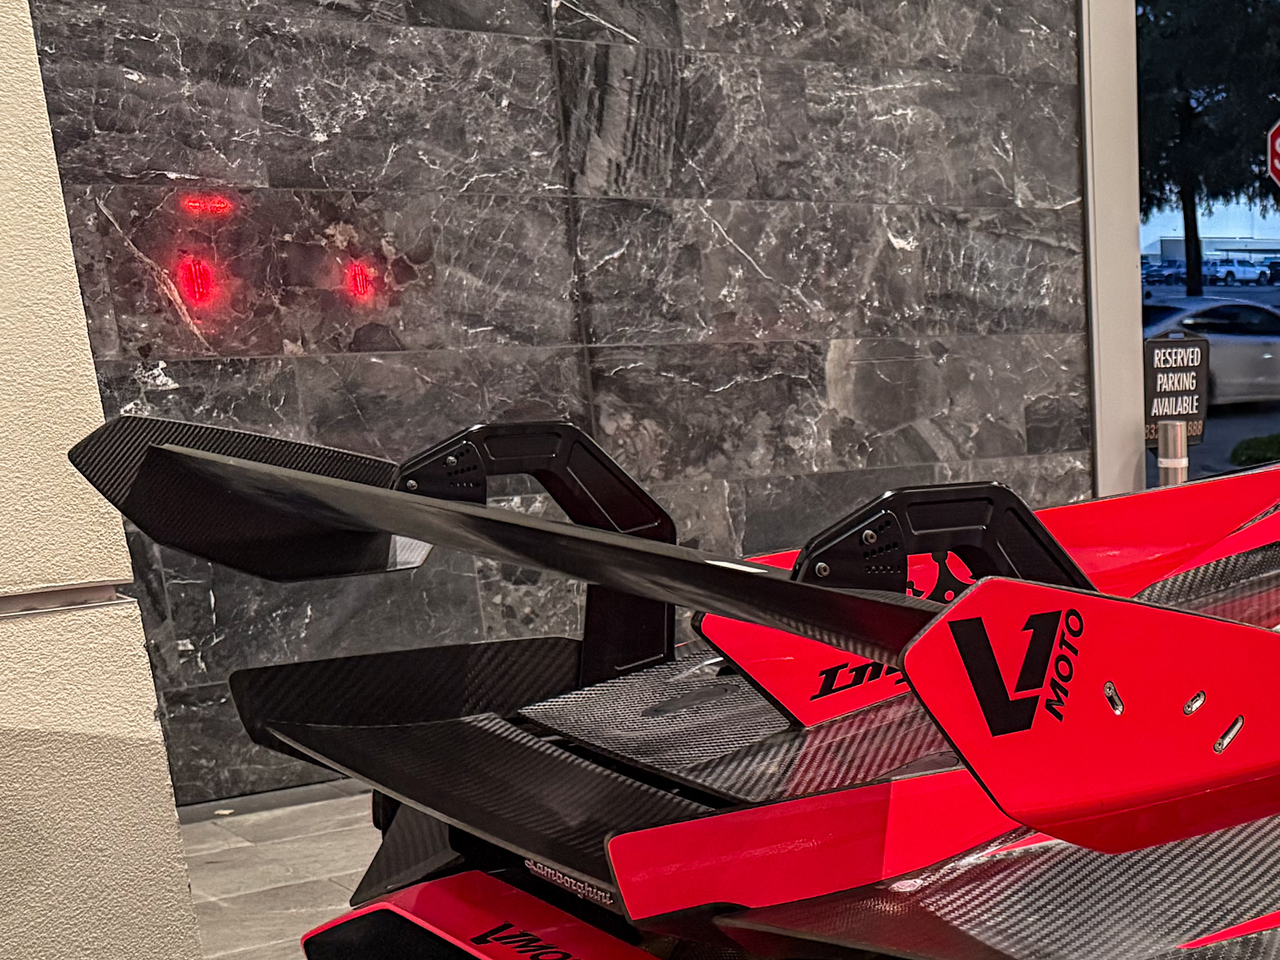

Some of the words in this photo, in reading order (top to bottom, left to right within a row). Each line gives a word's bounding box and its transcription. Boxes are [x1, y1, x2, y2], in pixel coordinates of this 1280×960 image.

[1153, 348, 1201, 368] RESERVED
[1156, 371, 1196, 393] PARKING
[1151, 395, 1199, 417] AVAILABLE
[1044, 608, 1084, 722] MOTO
[525, 859, 614, 905] Lamborghini
